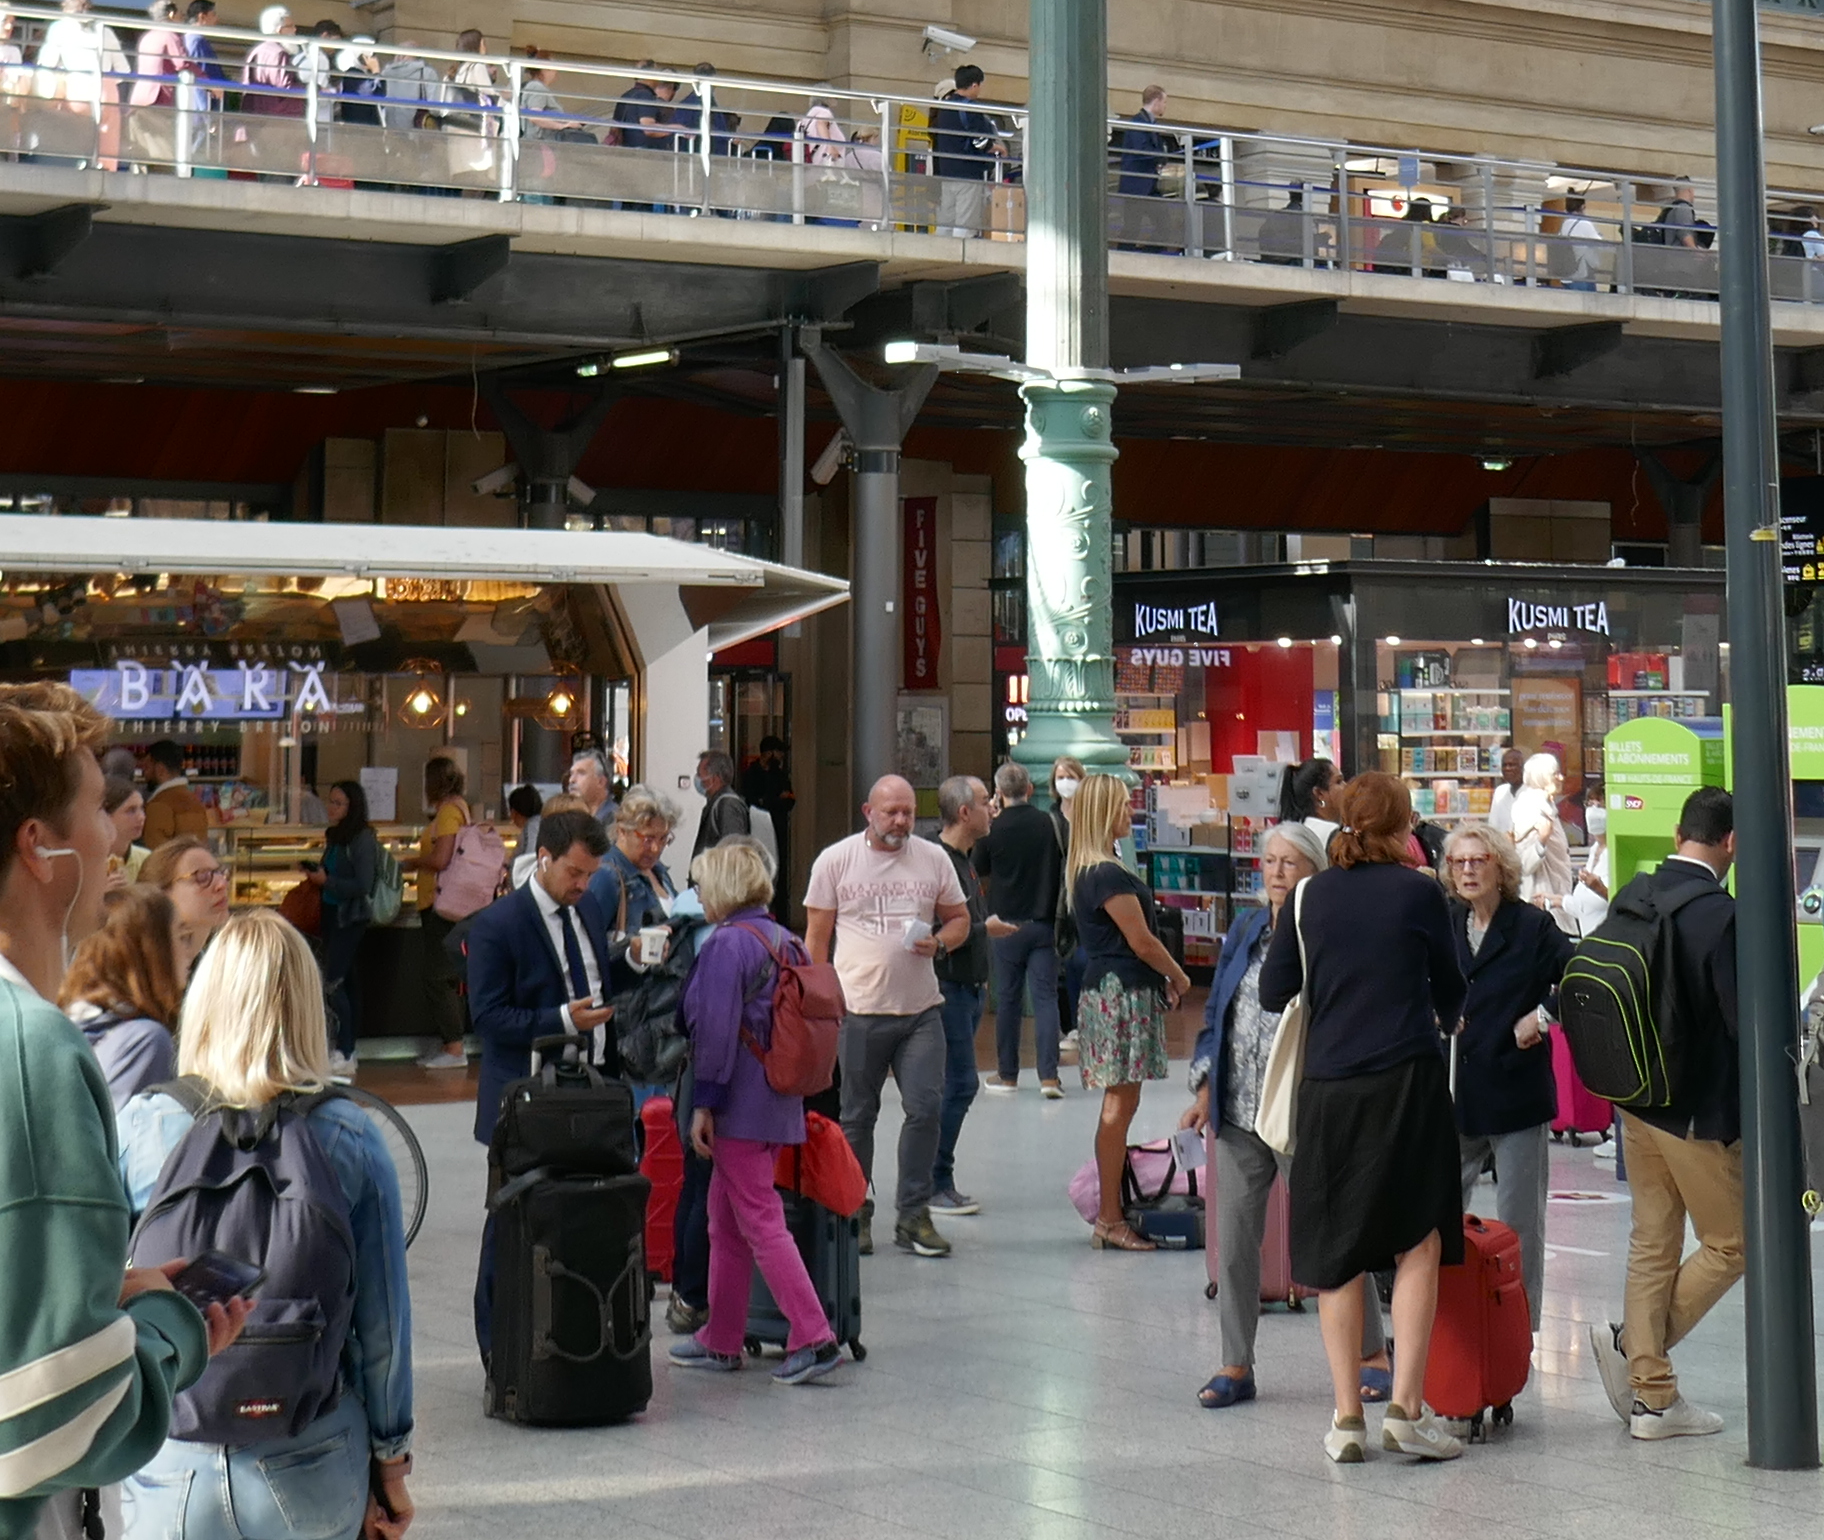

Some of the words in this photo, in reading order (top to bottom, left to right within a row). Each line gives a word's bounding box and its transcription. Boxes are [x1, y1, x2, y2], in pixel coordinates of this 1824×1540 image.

[914, 509, 928, 589] FIVE
[1135, 602, 1184, 638] KUSMI
[1187, 600, 1218, 637] TEA
[1507, 597, 1569, 634] KUSMI
[1573, 601, 1610, 637] TEA
[914, 596, 927, 678] GUYS
[1005, 707, 1029, 722] OPE
[117, 720, 220, 734] THIERRY
[239, 720, 331, 735] BRETON
[1607, 741, 1643, 753] BILLETS
[1608, 752, 1615, 764] &
[1617, 752, 1690, 766] ABONNEMENTS
[1612, 773, 1627, 783] TER
[1627, 773, 1694, 785] HAUTS-DE-FRANCE
[239, 1402, 280, 1414] EASTPAK
